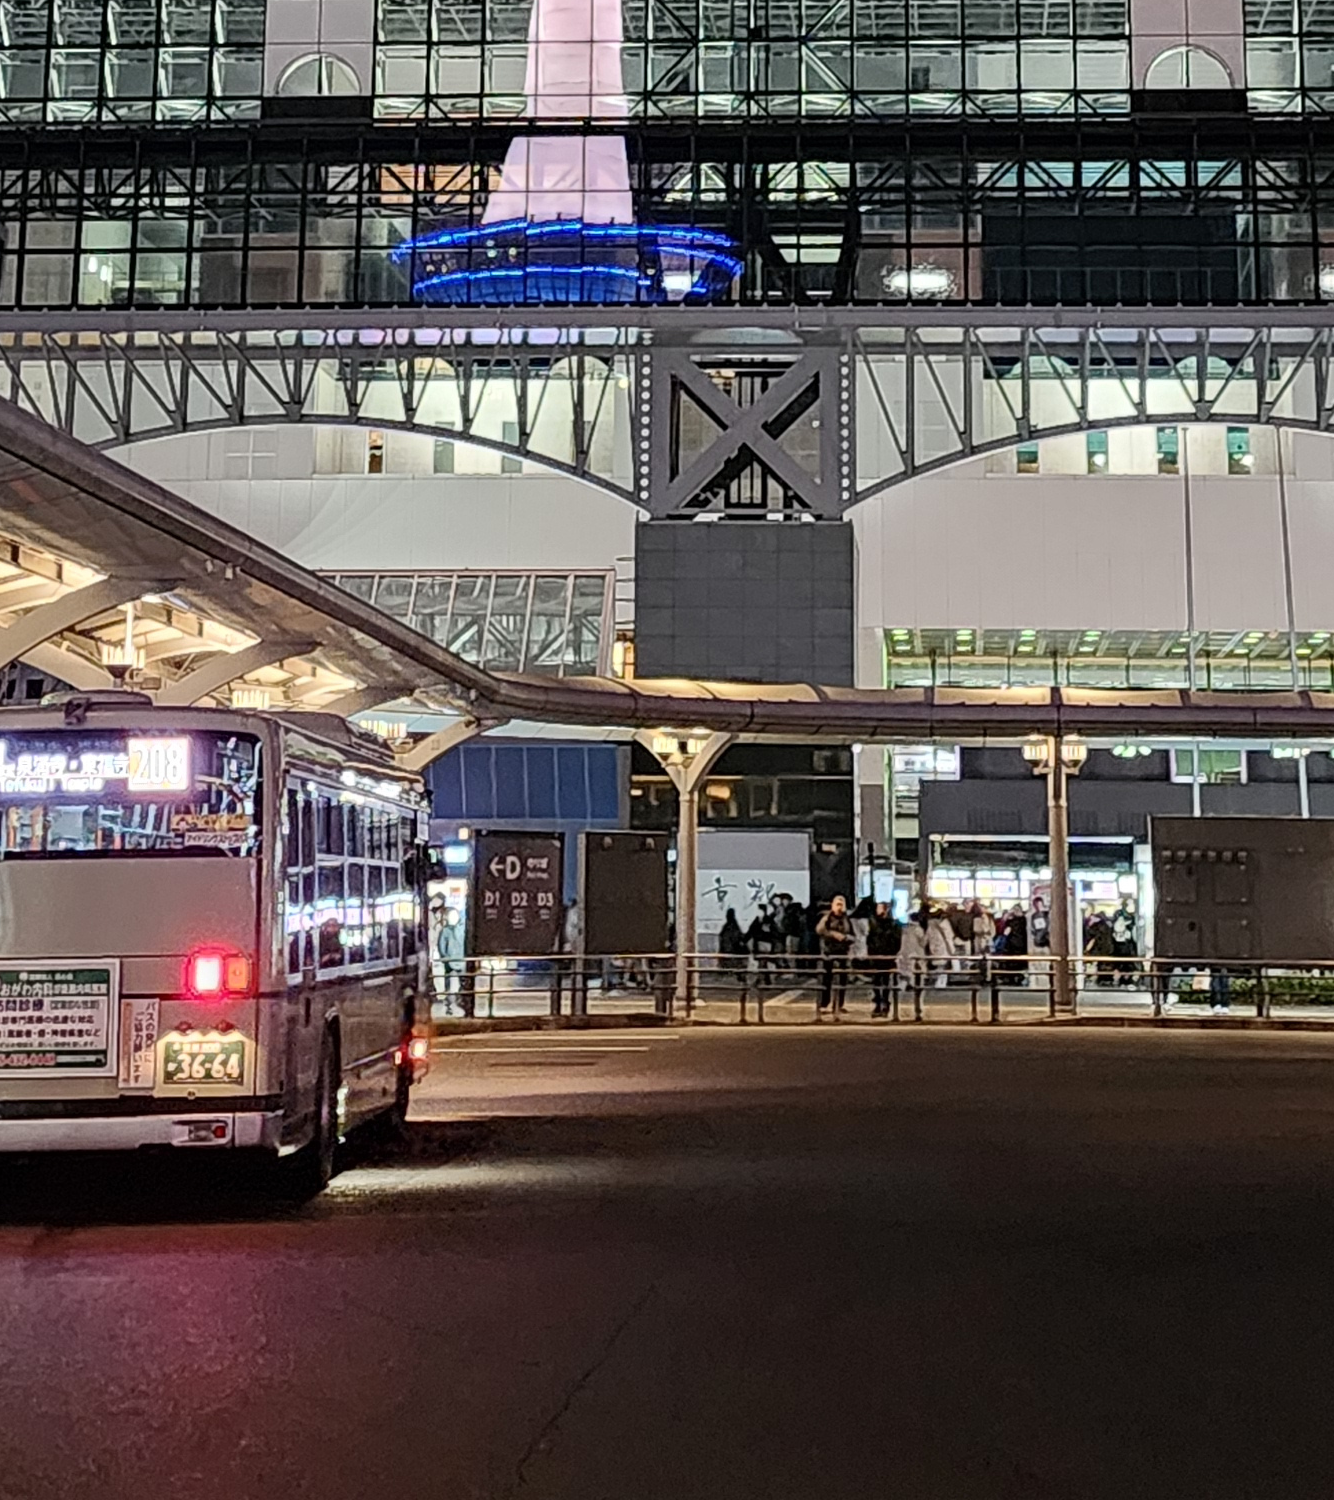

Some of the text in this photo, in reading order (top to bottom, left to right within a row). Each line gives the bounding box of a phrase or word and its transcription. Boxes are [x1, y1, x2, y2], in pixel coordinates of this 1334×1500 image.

[132, 743, 183, 784] 208
[505, 855, 521, 880] D
[484, 890, 501, 906] D1
[511, 891, 528, 907] D2
[537, 892, 554, 907] D3
